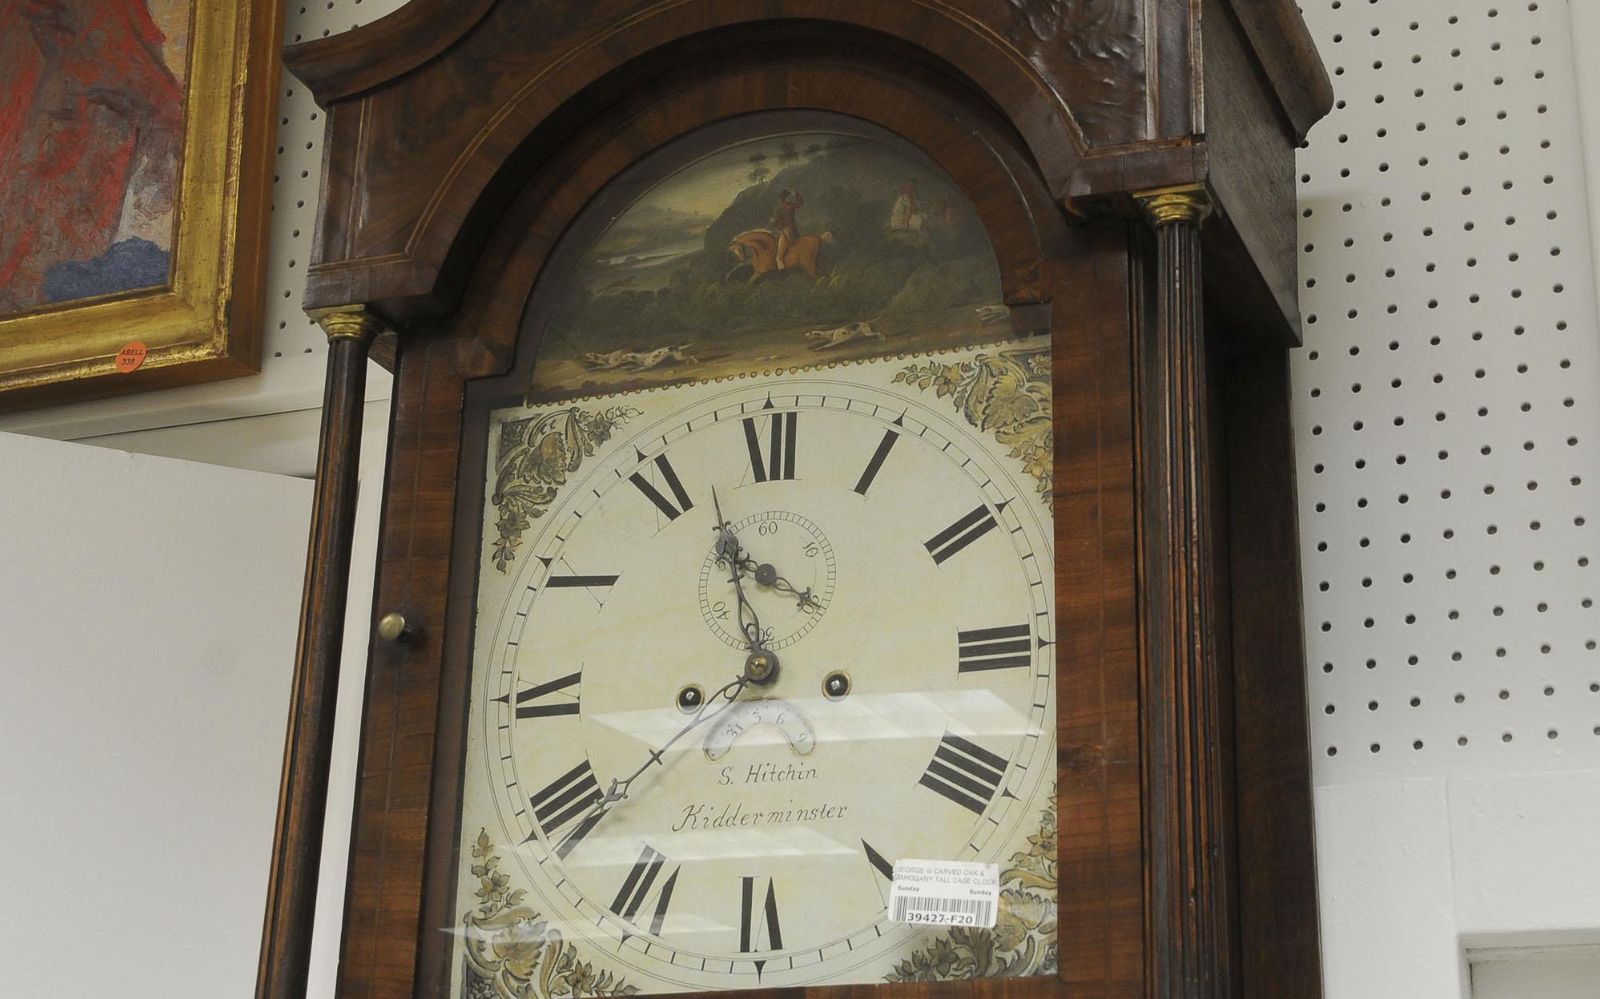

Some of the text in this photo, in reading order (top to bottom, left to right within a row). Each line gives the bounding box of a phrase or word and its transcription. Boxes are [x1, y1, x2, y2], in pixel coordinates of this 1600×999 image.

[758, 520, 778, 537] 60
[717, 761, 819, 786] S. Hitchin
[671, 799, 849, 833] Kidderminster
[934, 868, 962, 877] CARVED
[963, 869, 979, 878] OAK
[935, 875, 951, 884] TALL
[952, 876, 971, 885] CASE
[972, 878, 997, 887] CLOCK
[969, 888, 992, 896] Sunday
[907, 912, 973, 924] 39427-F20
